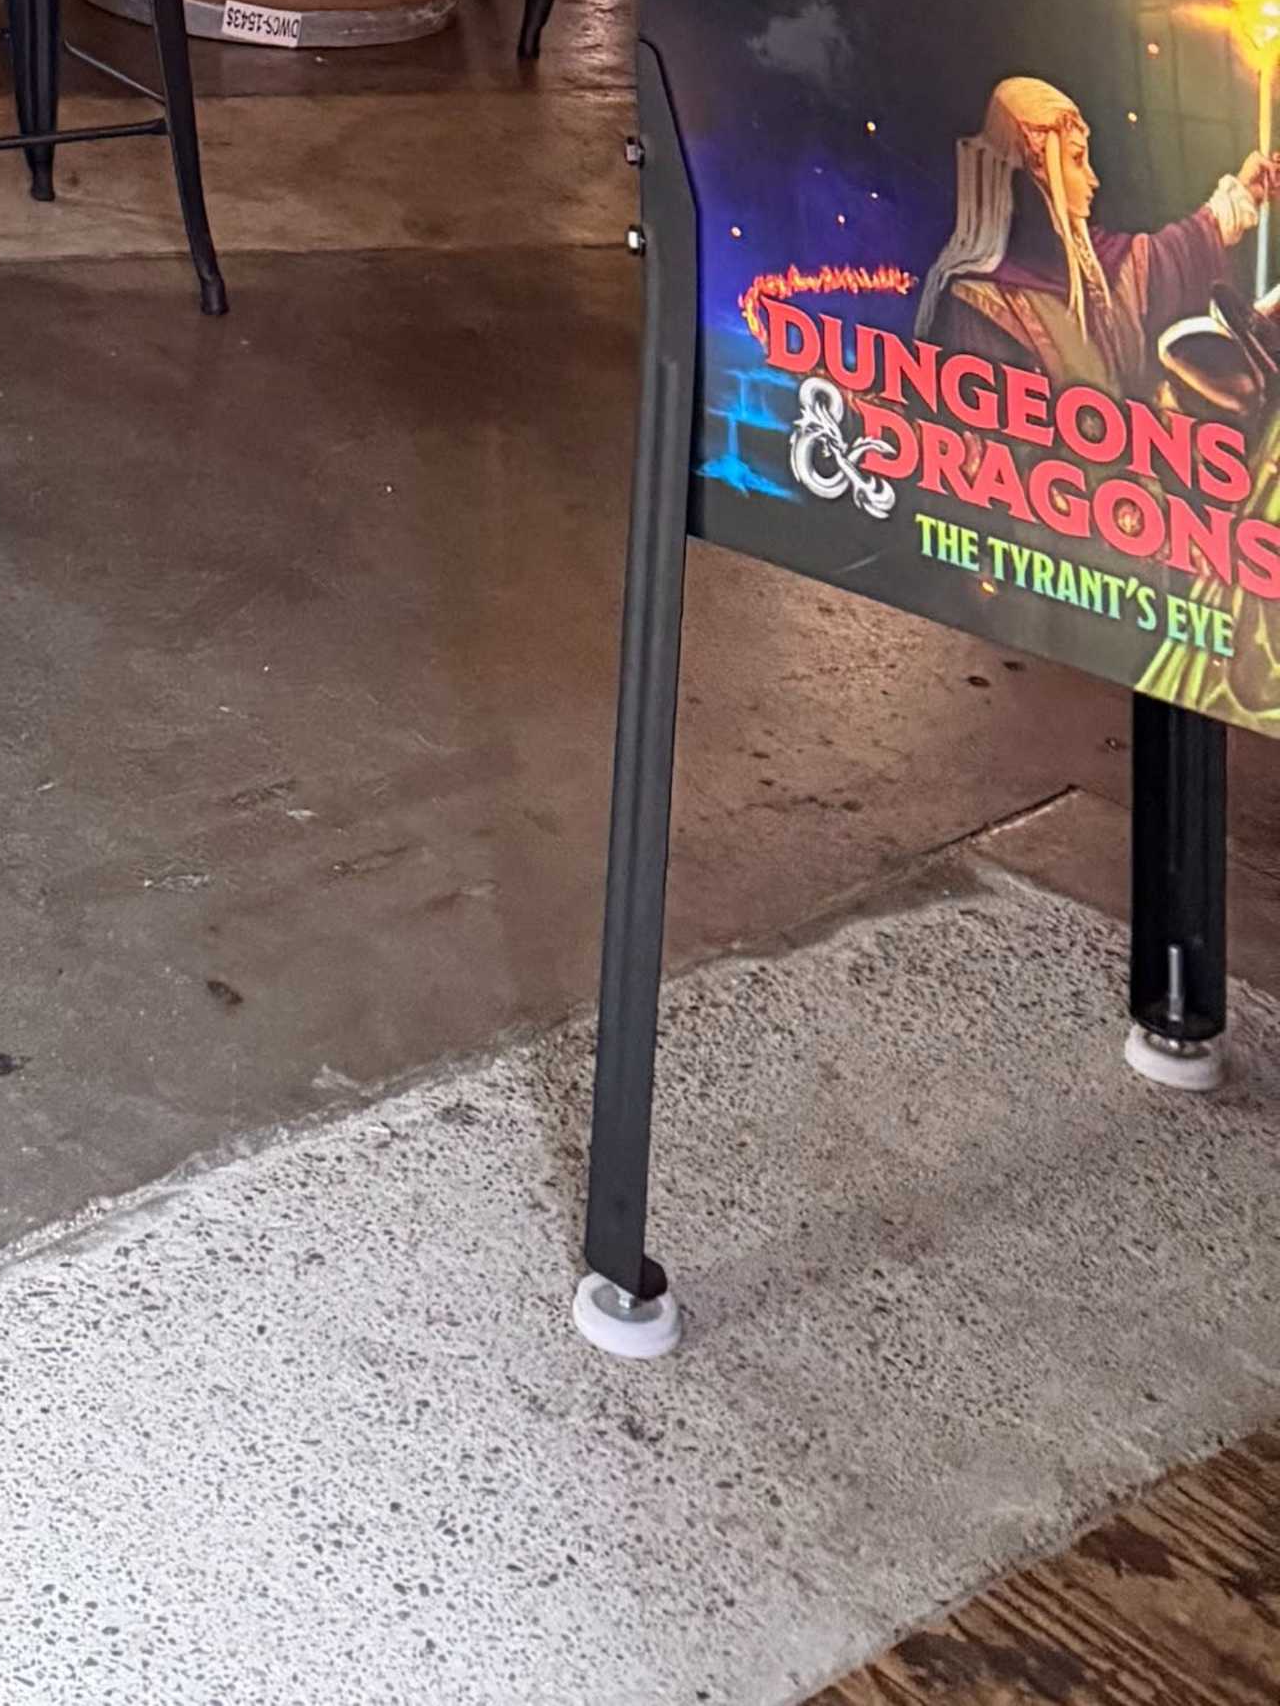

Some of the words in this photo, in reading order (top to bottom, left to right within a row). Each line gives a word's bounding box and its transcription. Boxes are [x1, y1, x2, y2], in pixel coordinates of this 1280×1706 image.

[760, 295, 1252, 504] DUNGEONS
[855, 399, 1280, 601] DRAGONS
[914, 513, 982, 573] THE
[986, 536, 1158, 633] TYRANT'S
[1166, 593, 1236, 658] EYE
